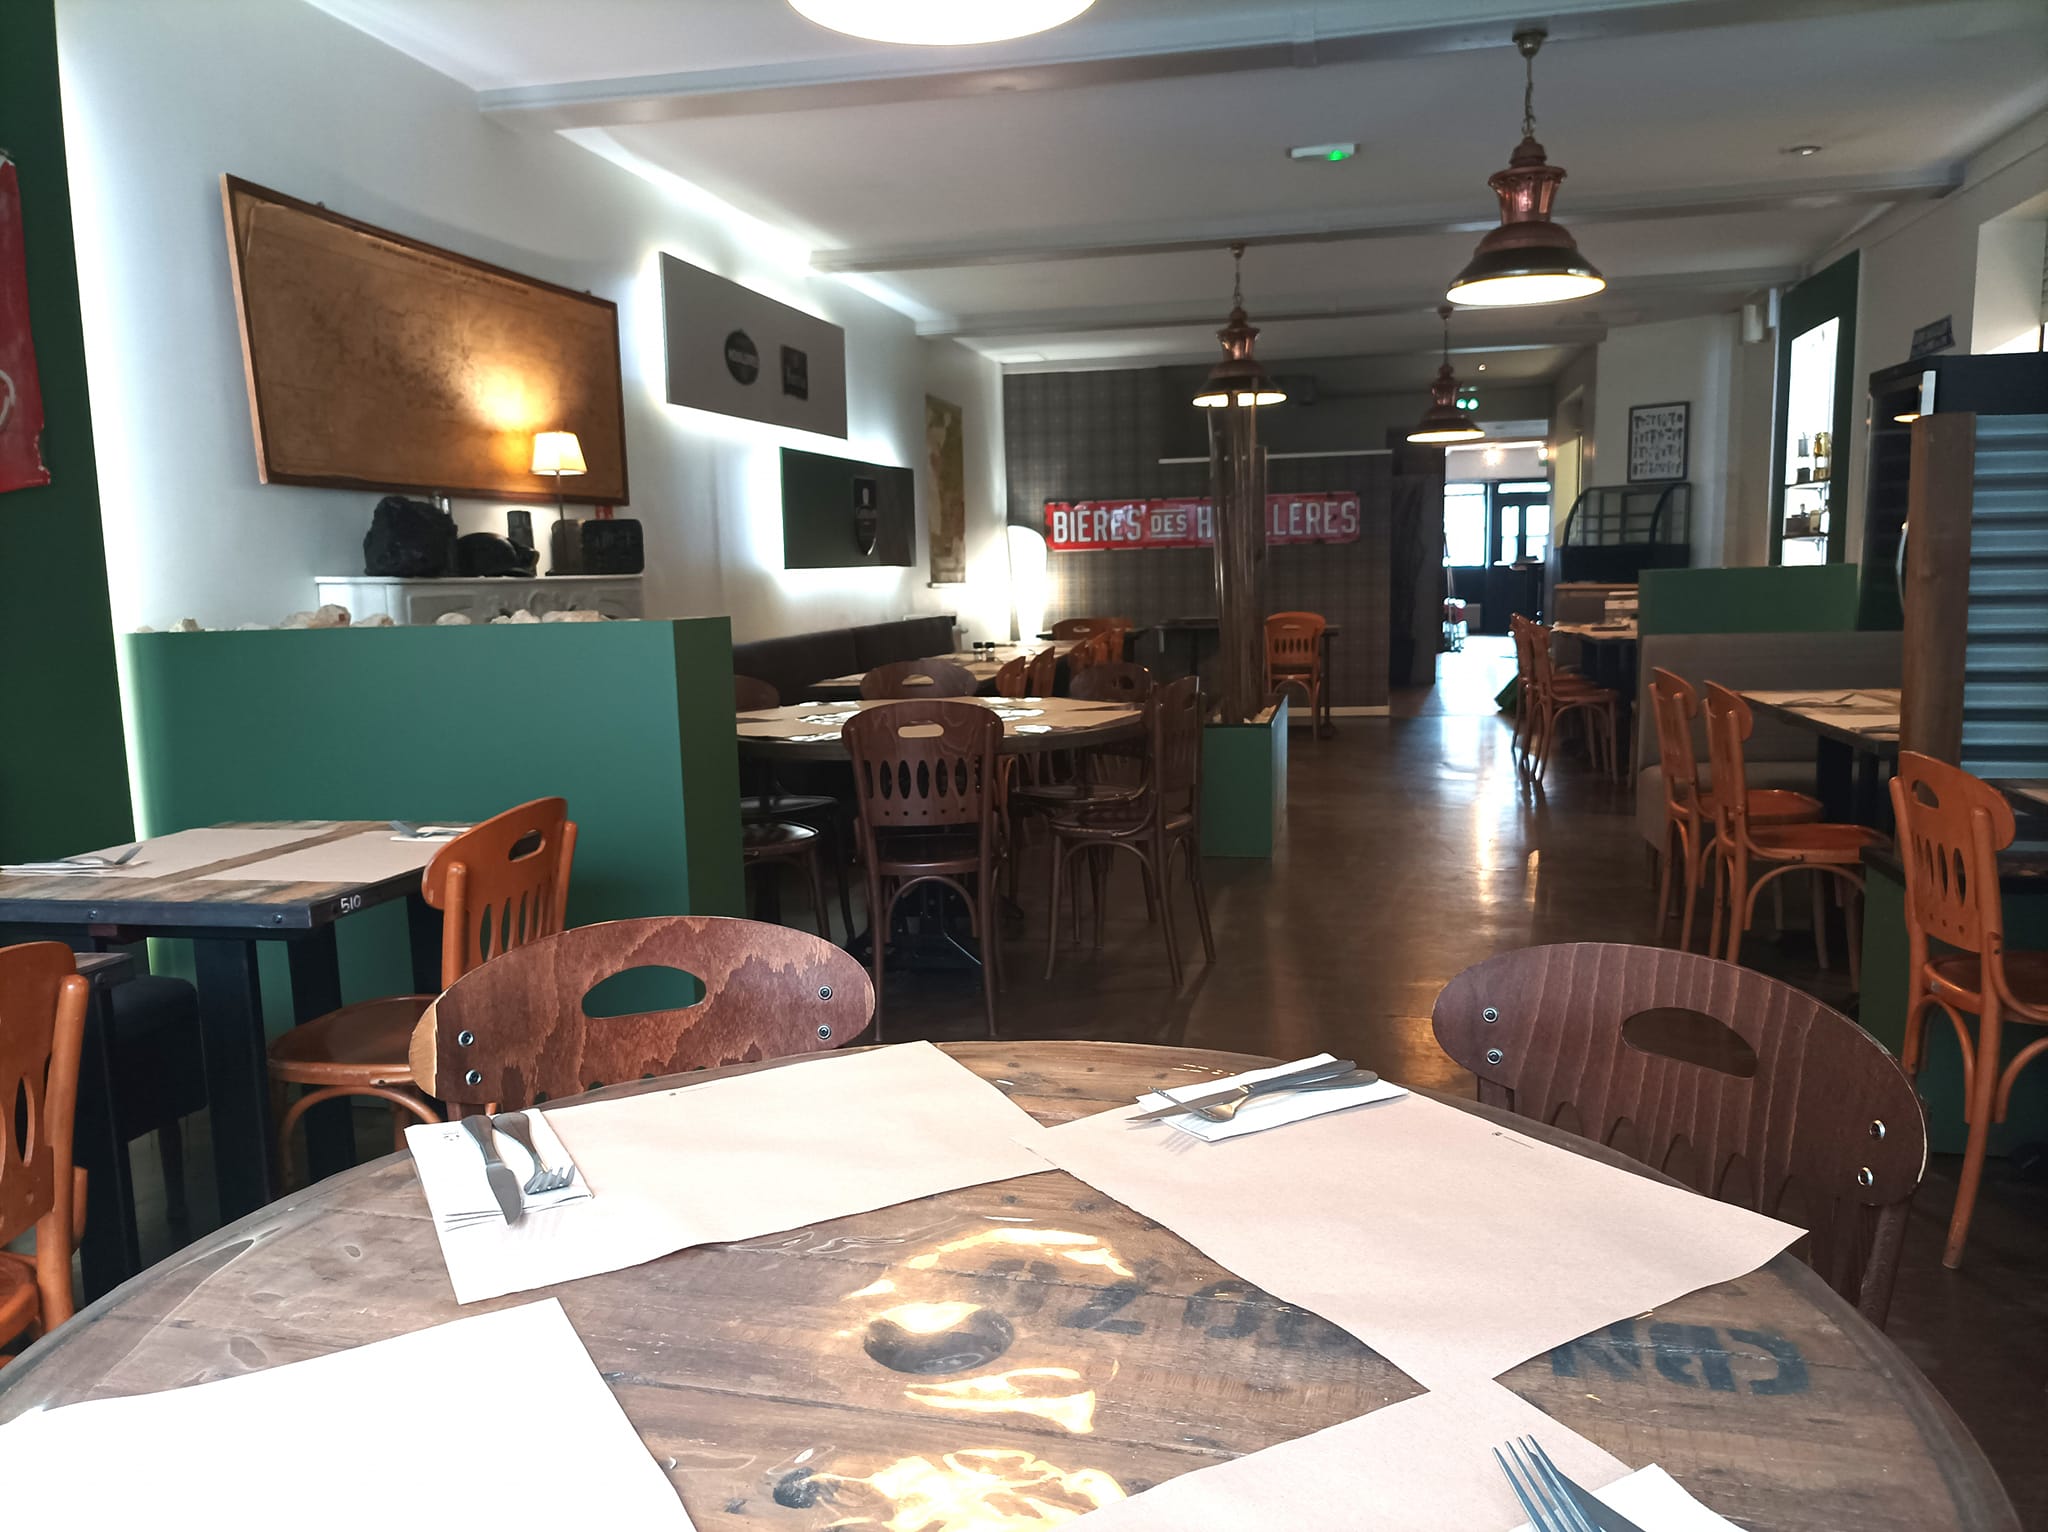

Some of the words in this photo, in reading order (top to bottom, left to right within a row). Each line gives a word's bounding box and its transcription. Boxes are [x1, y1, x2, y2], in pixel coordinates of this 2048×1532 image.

[1151, 514, 1187, 534] DES
[1197, 501, 1356, 539] HLERES
[340, 894, 362, 914] 510
